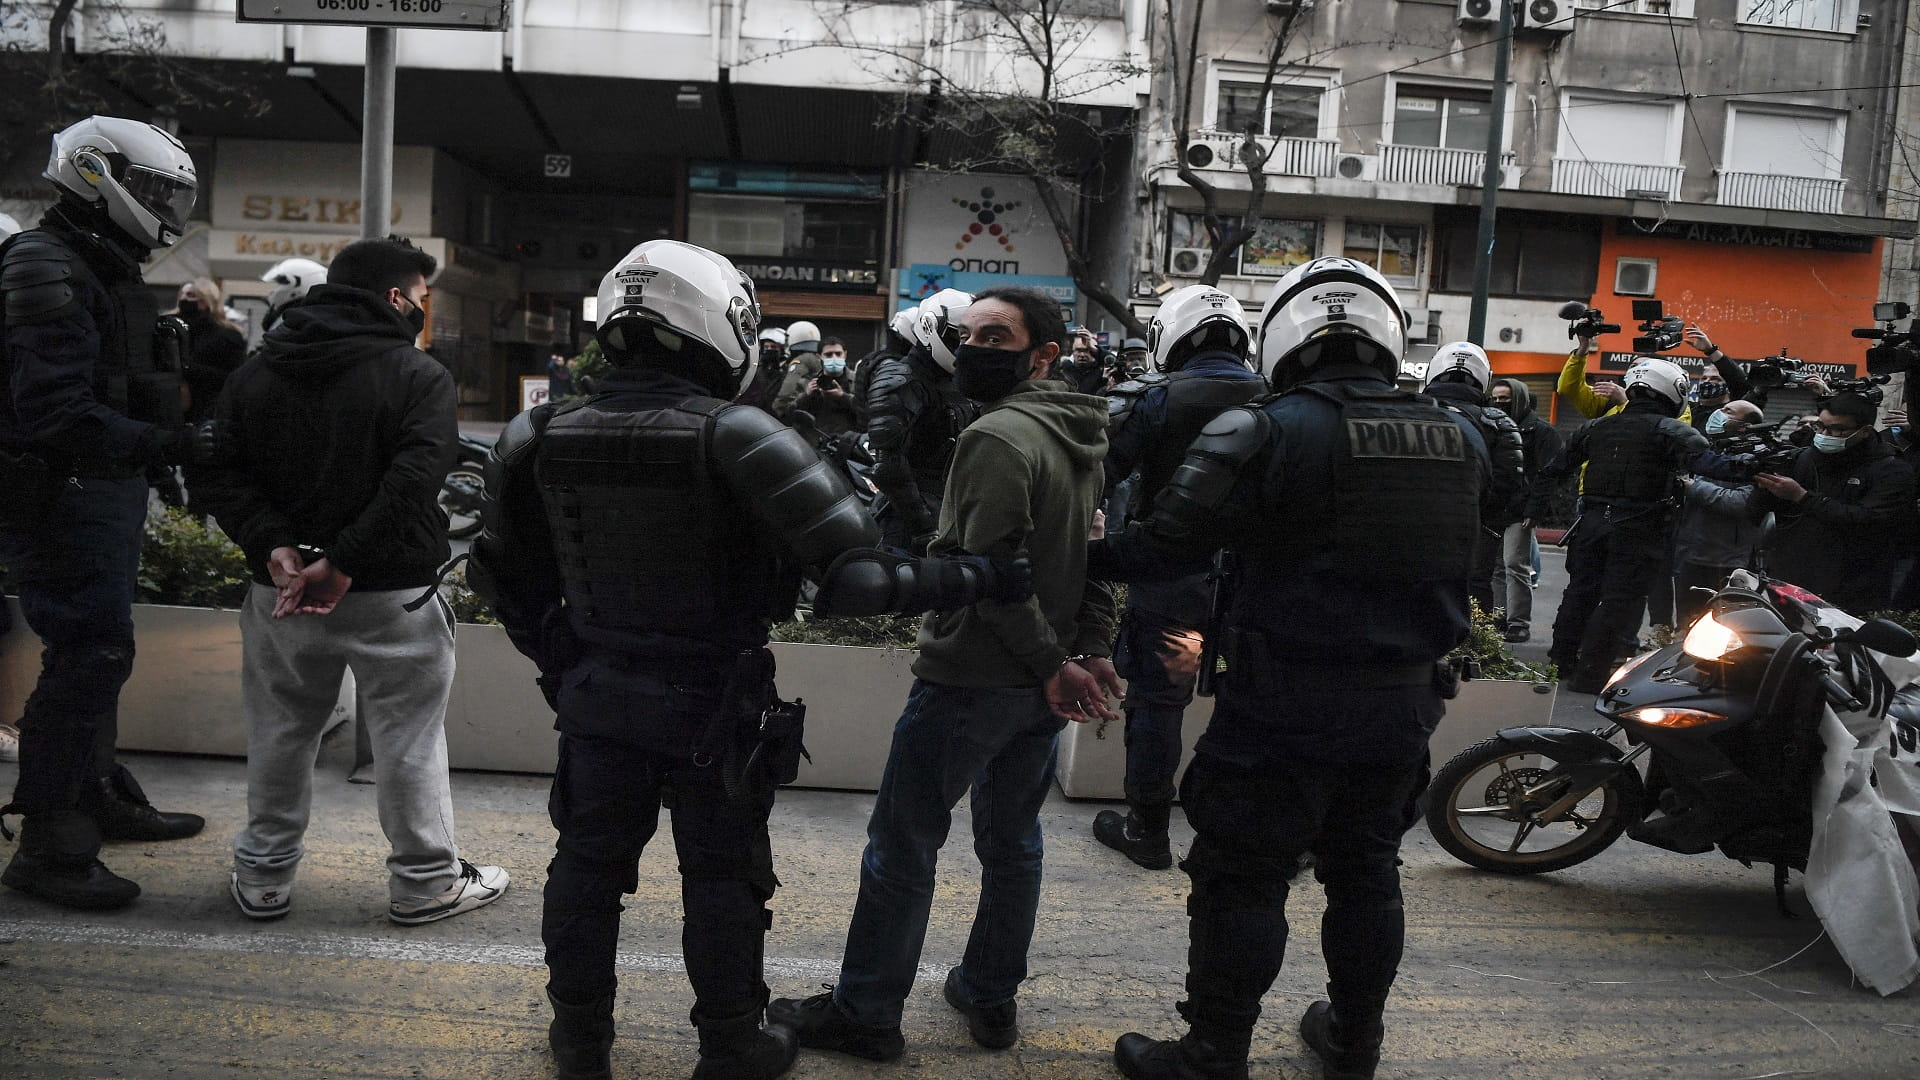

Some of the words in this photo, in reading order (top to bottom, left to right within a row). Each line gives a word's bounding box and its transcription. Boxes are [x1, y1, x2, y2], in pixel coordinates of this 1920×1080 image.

[317, 0, 369, 10] 06:00
[390, 0, 442, 13] 16:00
[547, 156, 570, 174] 59
[242, 194, 402, 224] SEIK
[615, 269, 659, 279] LS2
[820, 267, 878, 284] LINES
[1312, 292, 1357, 302] LS2
[1500, 328, 1523, 343] 61
[1352, 421, 1461, 458] POLICE
